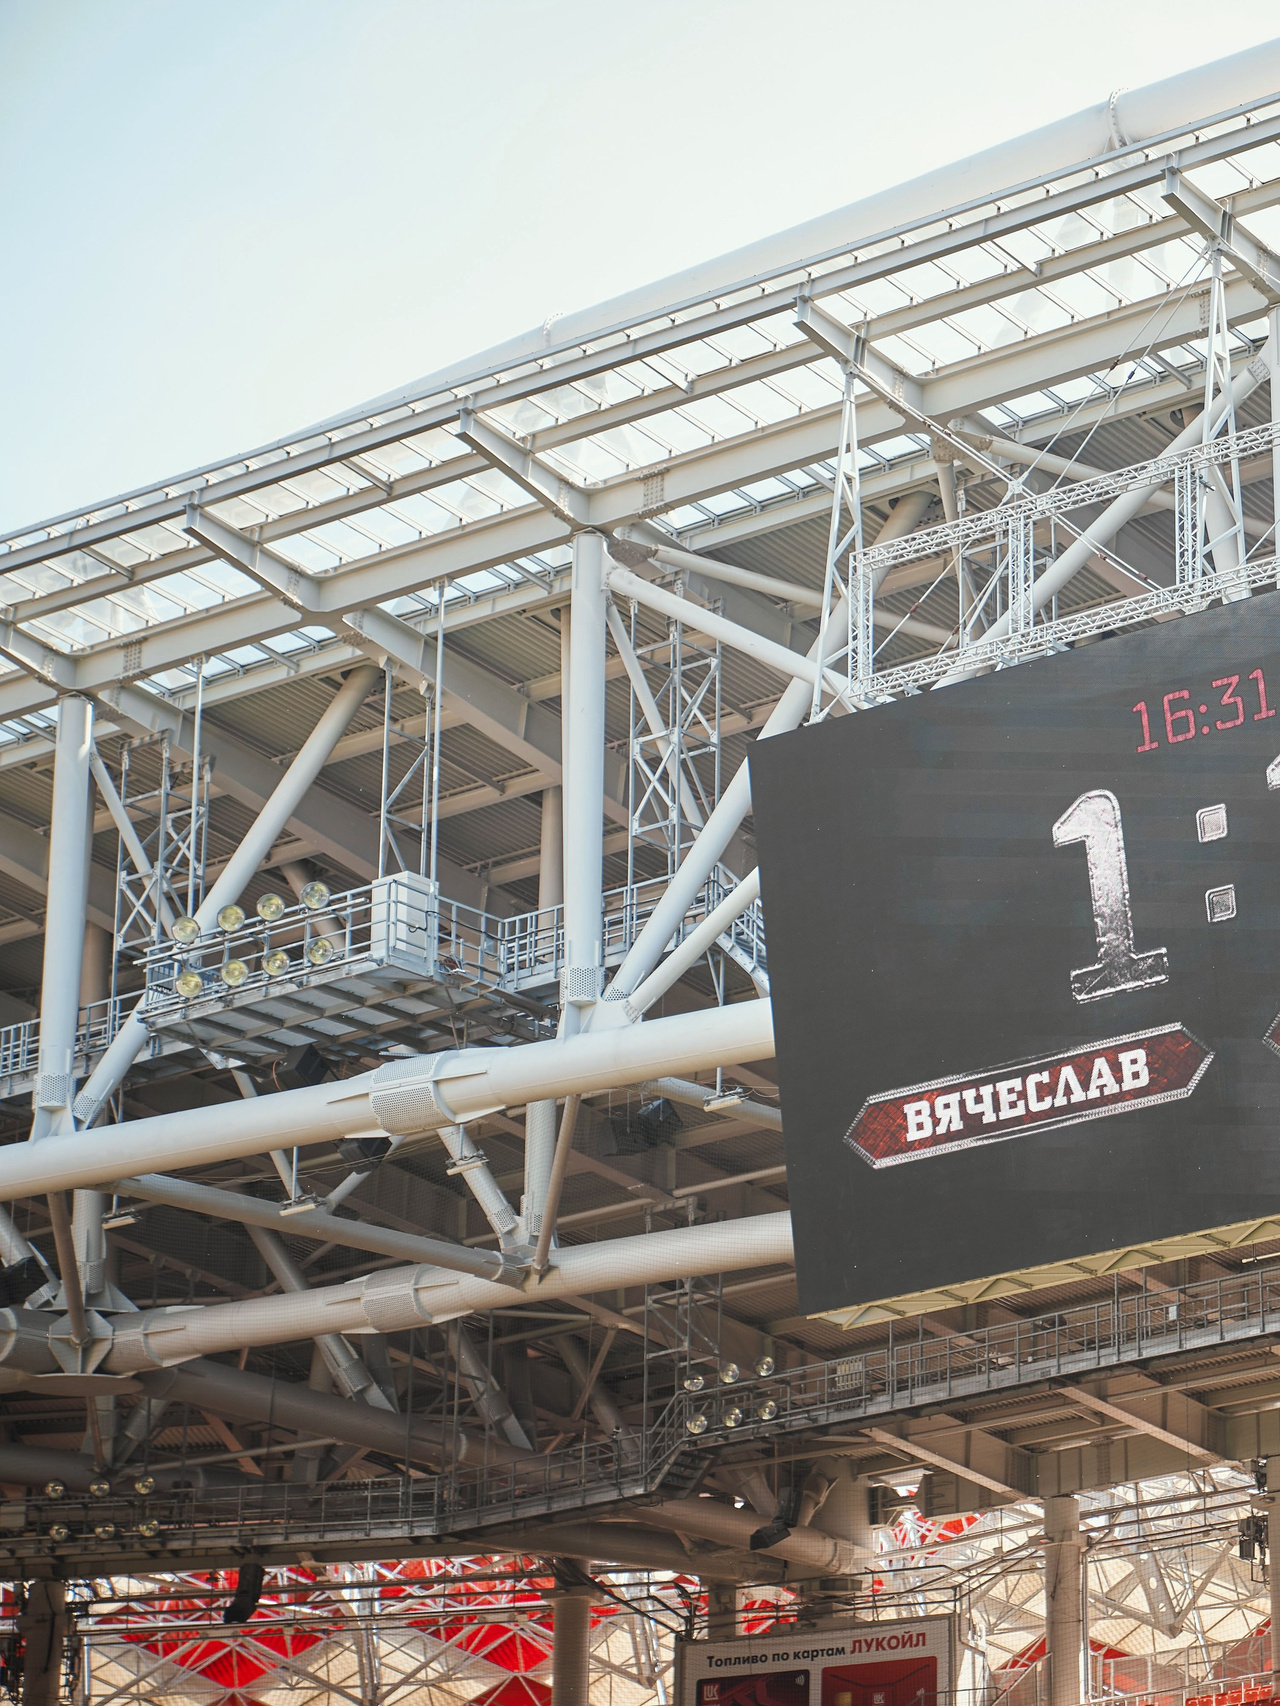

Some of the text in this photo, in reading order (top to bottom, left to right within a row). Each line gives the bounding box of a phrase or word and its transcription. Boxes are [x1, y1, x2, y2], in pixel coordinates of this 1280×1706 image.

[1132, 668, 1276, 753] 16:31
[904, 1050, 1150, 1142] ВЯЧЕСЛАВ
[707, 1631, 926, 1668] Топливо по картам ЛУКОЙЛ
